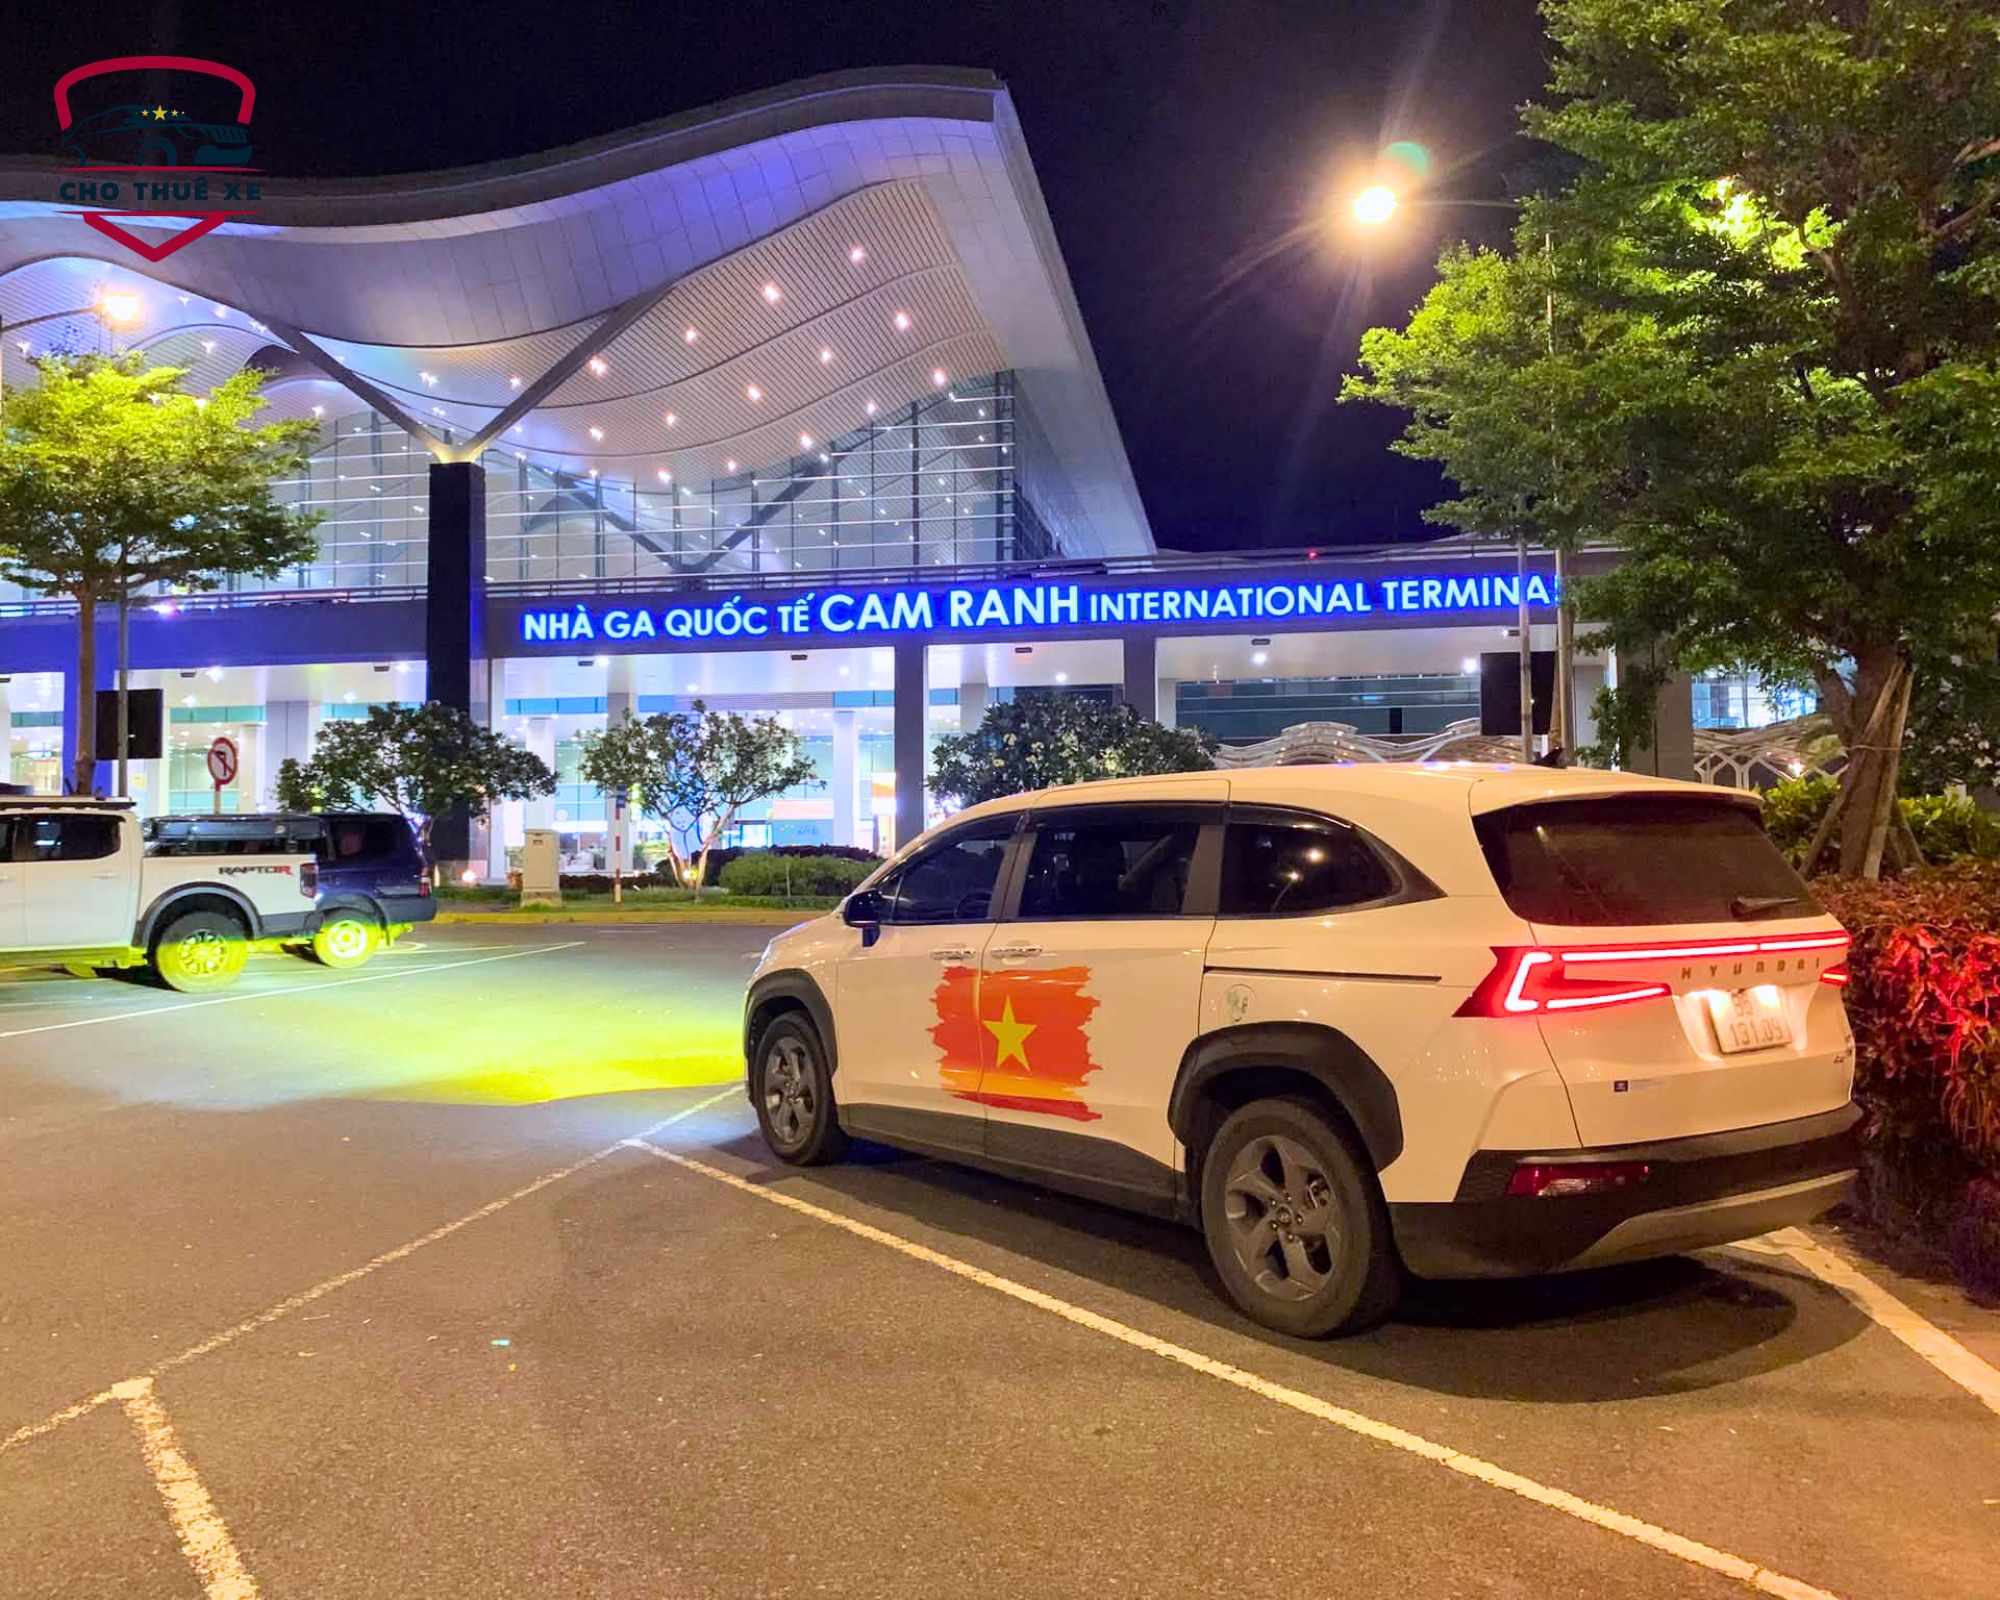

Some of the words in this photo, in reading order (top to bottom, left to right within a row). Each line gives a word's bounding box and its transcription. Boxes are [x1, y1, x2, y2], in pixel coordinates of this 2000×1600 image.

[524, 604, 594, 640] NHÀ
[603, 610, 656, 639] GA
[664, 595, 767, 638] QUỐC
[777, 593, 815, 633] TẾ
[820, 591, 933, 632] CAM
[950, 585, 1078, 627] RANH
[1090, 583, 1372, 622] INTERNATIONAL
[218, 865, 293, 876] RAPTOR
[1681, 957, 1820, 980] HYUNDAI
